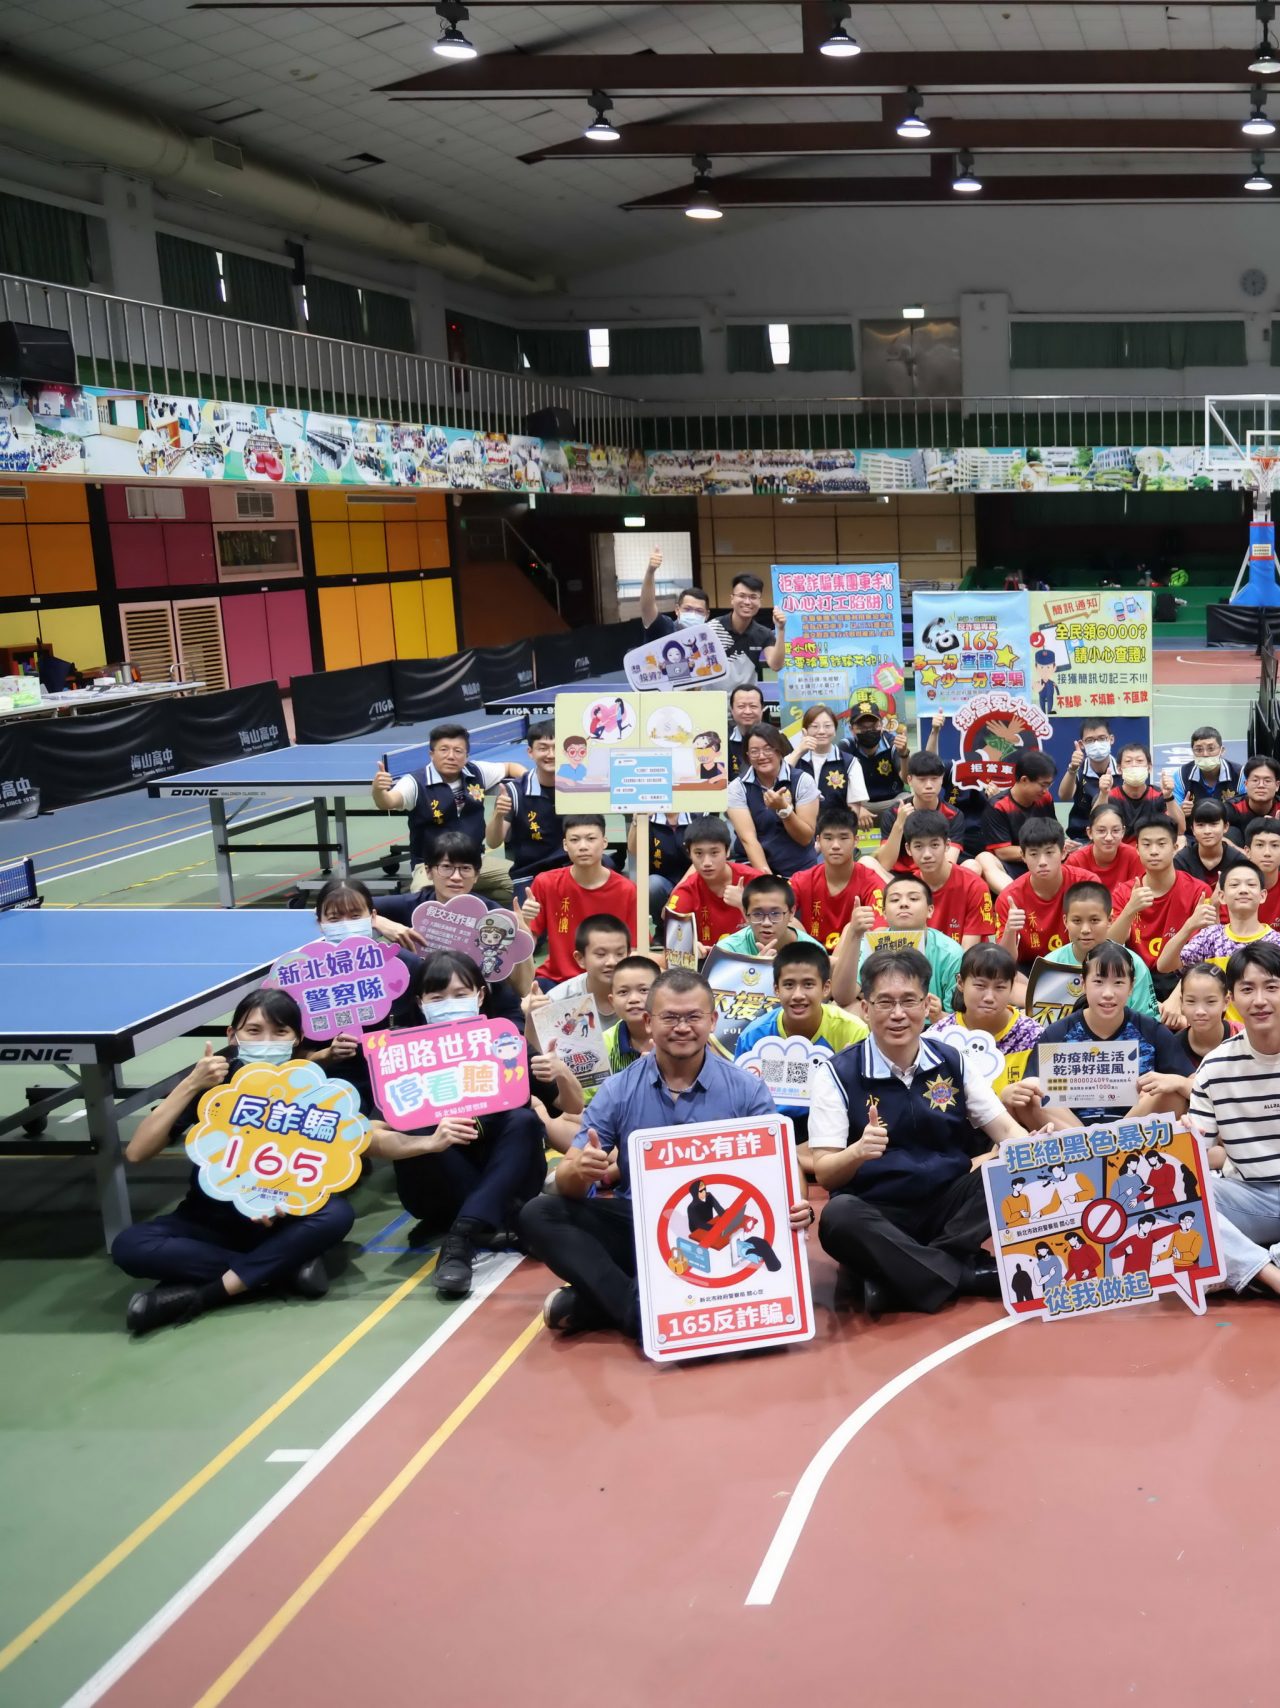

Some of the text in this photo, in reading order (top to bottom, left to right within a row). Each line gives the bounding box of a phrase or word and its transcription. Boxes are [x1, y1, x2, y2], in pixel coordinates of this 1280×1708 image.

[1052, 597, 1098, 615] 簡訊通知
[962, 631, 998, 651] 165
[1055, 622, 1148, 640] 全民領6000?
[1074, 646, 1147, 664] 請小心查證!
[369, 699, 394, 716] STIGA
[533, 706, 556, 716] ST-9
[238, 724, 278, 748] 海山高中
[130, 748, 173, 771] 海山高中
[0, 777, 32, 799] 高中
[171, 789, 219, 797] DONIC
[426, 906, 477, 929] 假交友詐騙
[278, 944, 384, 987] 新北婦幼
[304, 976, 385, 1014] 警察隊
[377, 1027, 494, 1077] 網路世界
[1053, 1051, 1125, 1064] 防疫新生活
[386, 1062, 497, 1114] 停看聽
[229, 1094, 341, 1143] 反詐騙
[658, 1132, 761, 1166] 小心有詐
[1006, 1120, 1173, 1173] 拒絕黑色暴力
[225, 1136, 326, 1187] 165
[1016, 1220, 1059, 1238] 新北市政府警察局
[1044, 1271, 1152, 1314] 從我做起
[668, 1302, 784, 1337] 165反詐騙
